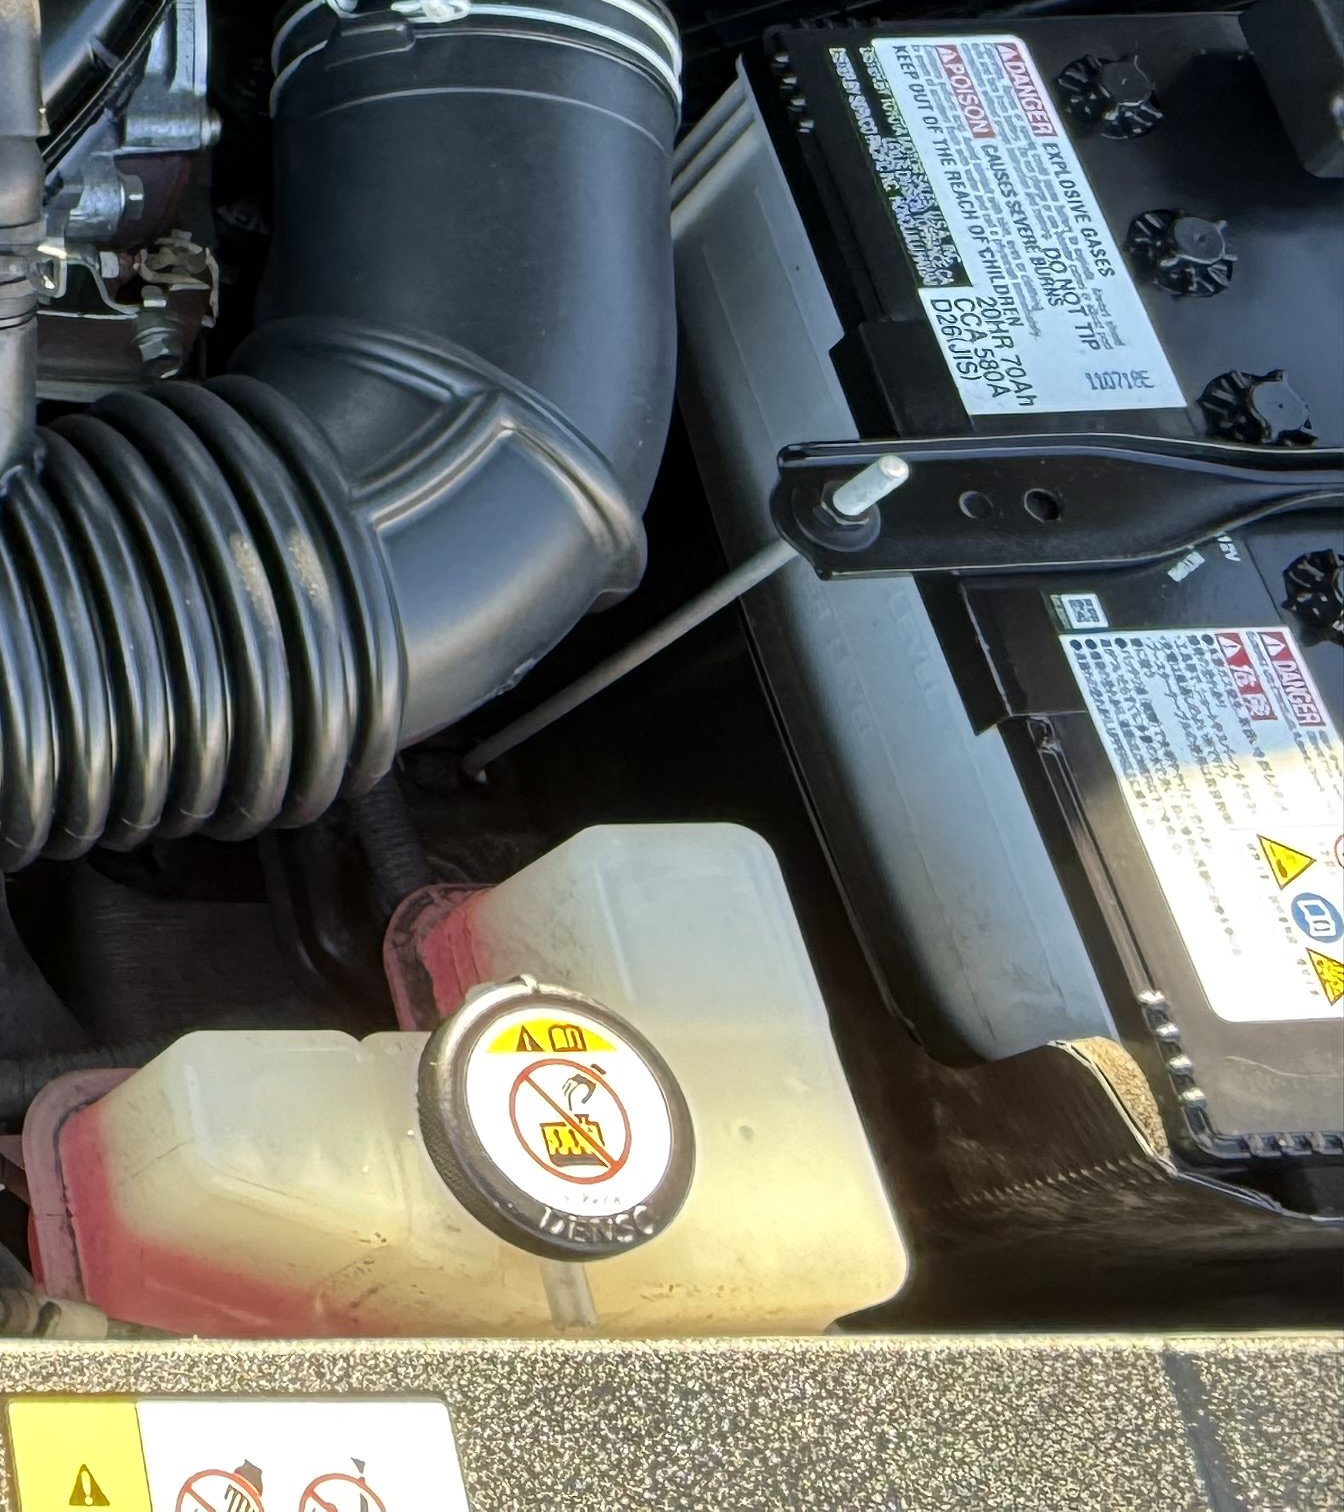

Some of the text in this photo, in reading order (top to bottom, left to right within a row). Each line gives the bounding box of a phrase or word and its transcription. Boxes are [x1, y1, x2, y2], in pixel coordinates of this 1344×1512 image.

[891, 45, 921, 80] KEEP
[907, 83, 934, 111] OUT
[921, 115, 943, 134] OF
[931, 139, 958, 167] THE
[942, 63, 1066, 307] POISON CAUSES SEVERE BURNS
[944, 169, 980, 220] REACH
[1002, 61, 1056, 135] DANGER
[1040, 142, 1093, 223] EXPLOSIVE
[1078, 227, 1117, 277] GASES
[966, 224, 990, 244] OF
[975, 246, 1025, 327] CHILDREN
[1040, 247, 1102, 350] DO NOT TIP
[927, 298, 983, 381] D26(JIS)
[950, 297, 1013, 398] CCA 580A
[973, 295, 1040, 407] 20HR 70Ah
[1276, 660, 1322, 724] DANGER
